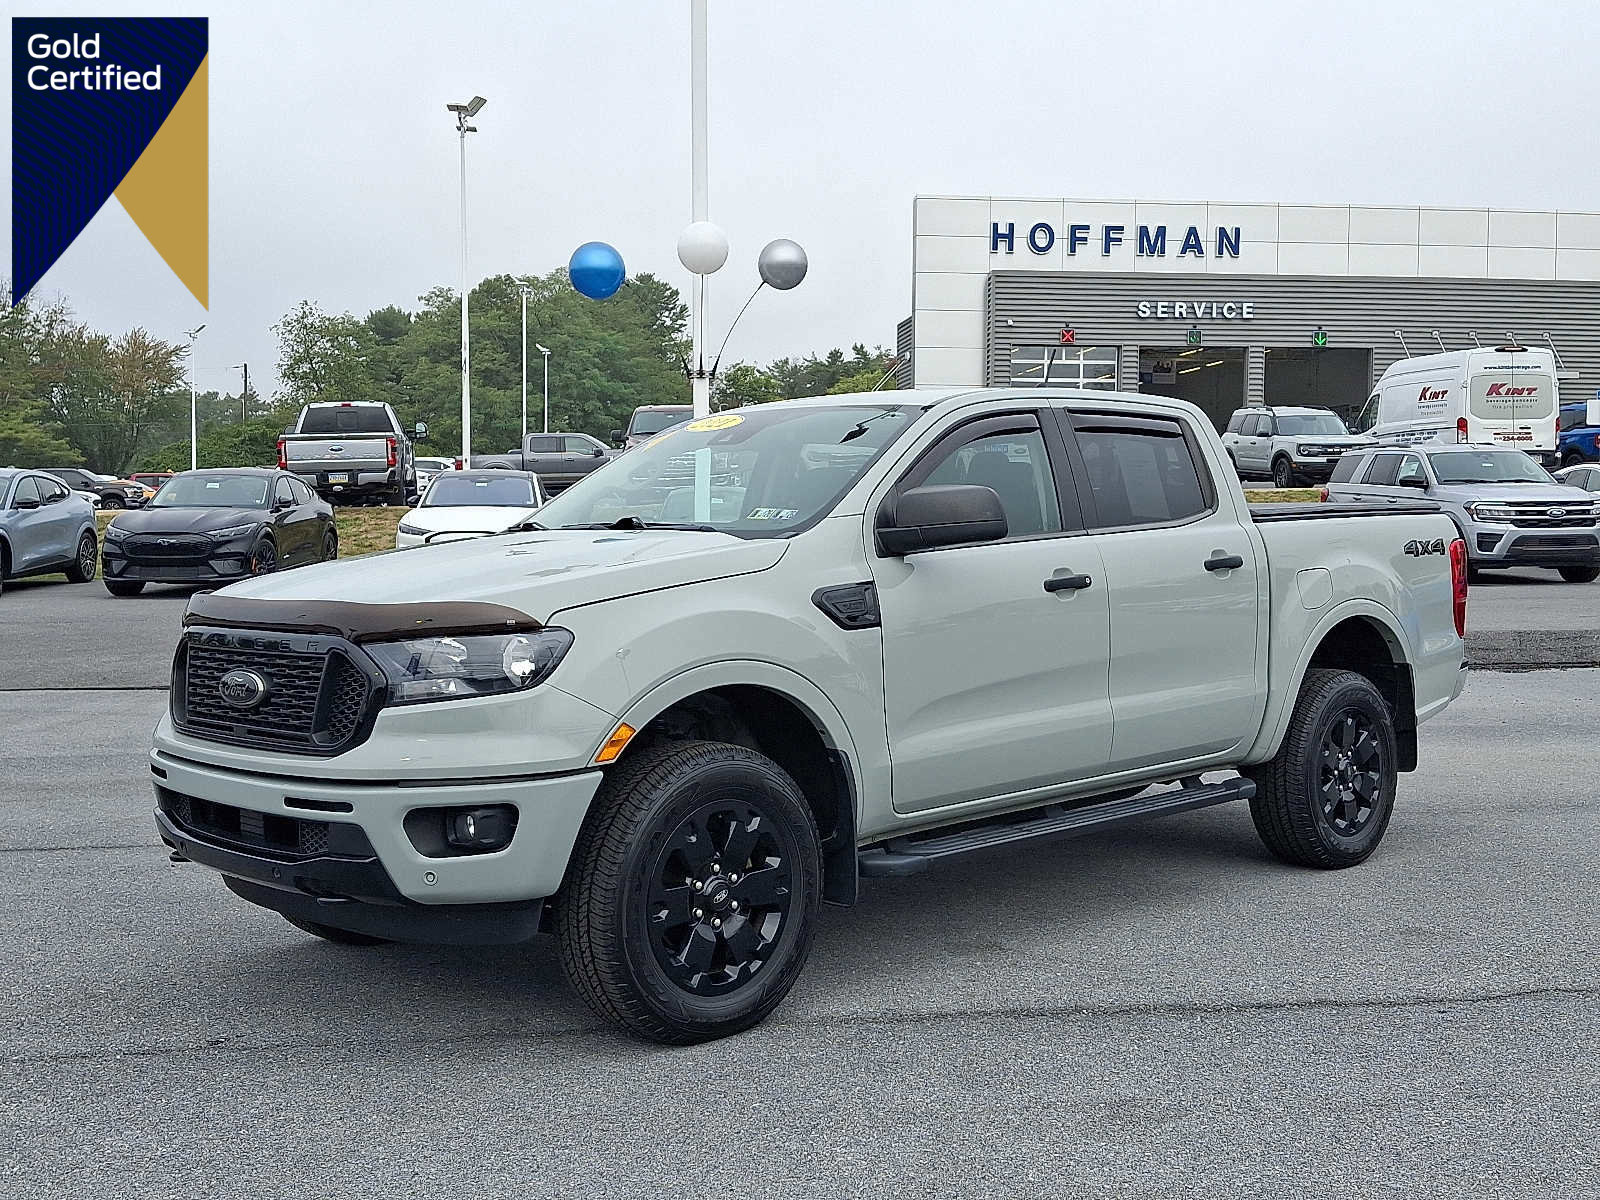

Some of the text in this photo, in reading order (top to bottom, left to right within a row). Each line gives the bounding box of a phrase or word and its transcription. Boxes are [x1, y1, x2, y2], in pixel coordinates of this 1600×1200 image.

[990, 222, 1241, 257] HOFFMAN
[1137, 301, 1254, 319] SERVICE
[1418, 385, 1449, 402] KINT
[1486, 382, 1538, 397] KINT
